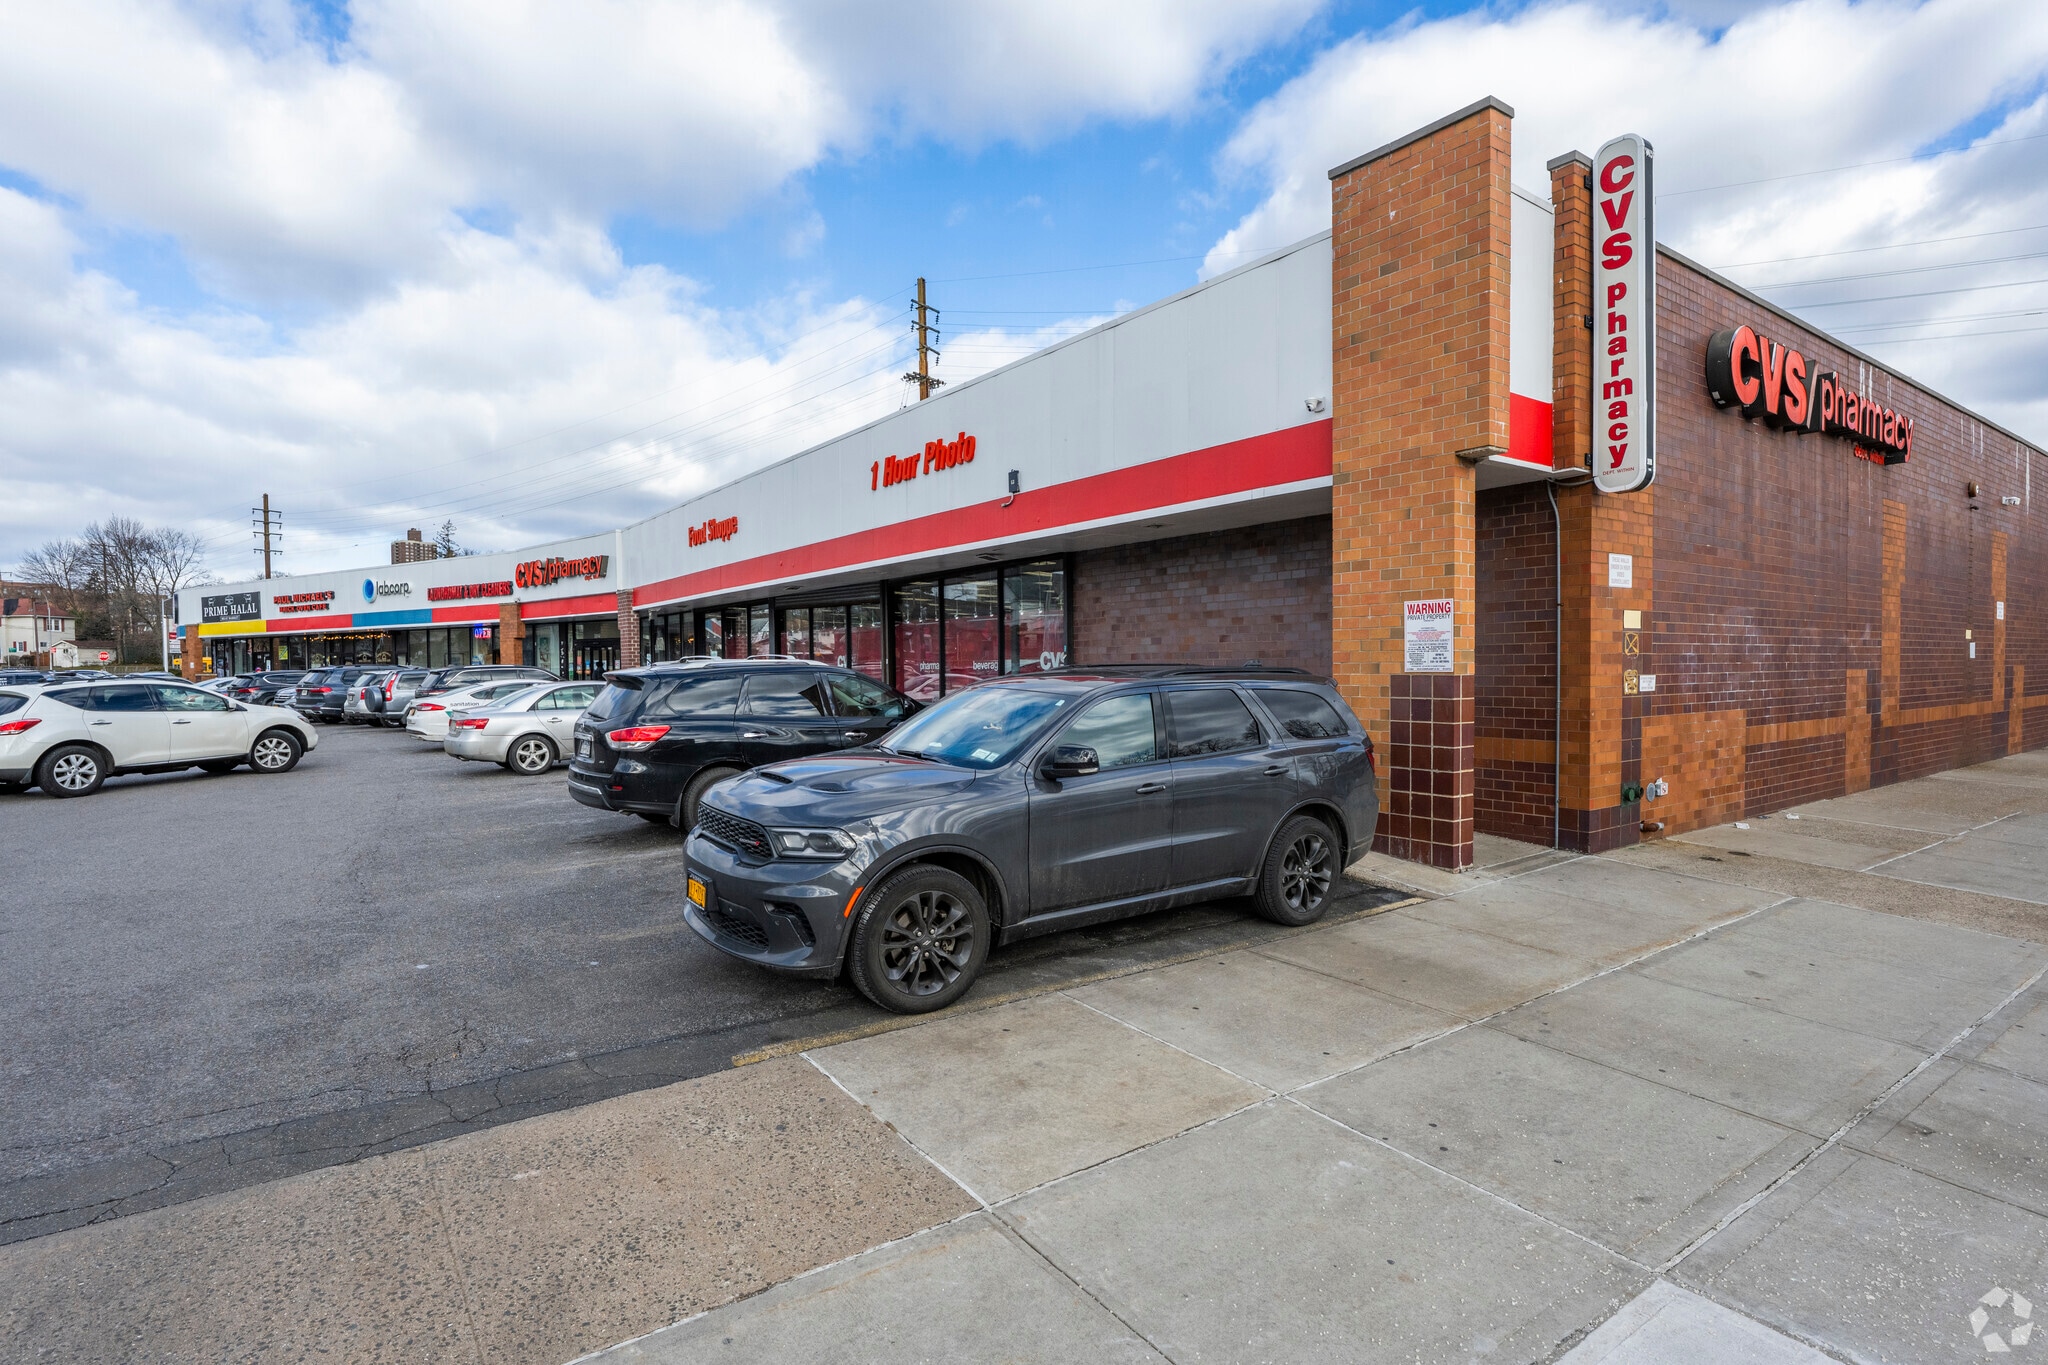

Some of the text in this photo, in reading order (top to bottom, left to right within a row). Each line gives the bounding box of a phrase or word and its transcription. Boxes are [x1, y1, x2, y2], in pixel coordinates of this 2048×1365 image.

[1600, 154, 1634, 469] CVS pharmacy
[870, 432, 976, 490] 1 Hour Photo
[688, 515, 738, 547] Food Shoppe
[376, 580, 411, 597] labcorp
[481, 581, 510, 596] CLEANERS
[273, 590, 333, 604] PAUL MICHAEL'S
[203, 602, 258, 617] PRIME HALAL
[1407, 602, 1451, 614] WARNING
[474, 628, 491, 638] OPEN
